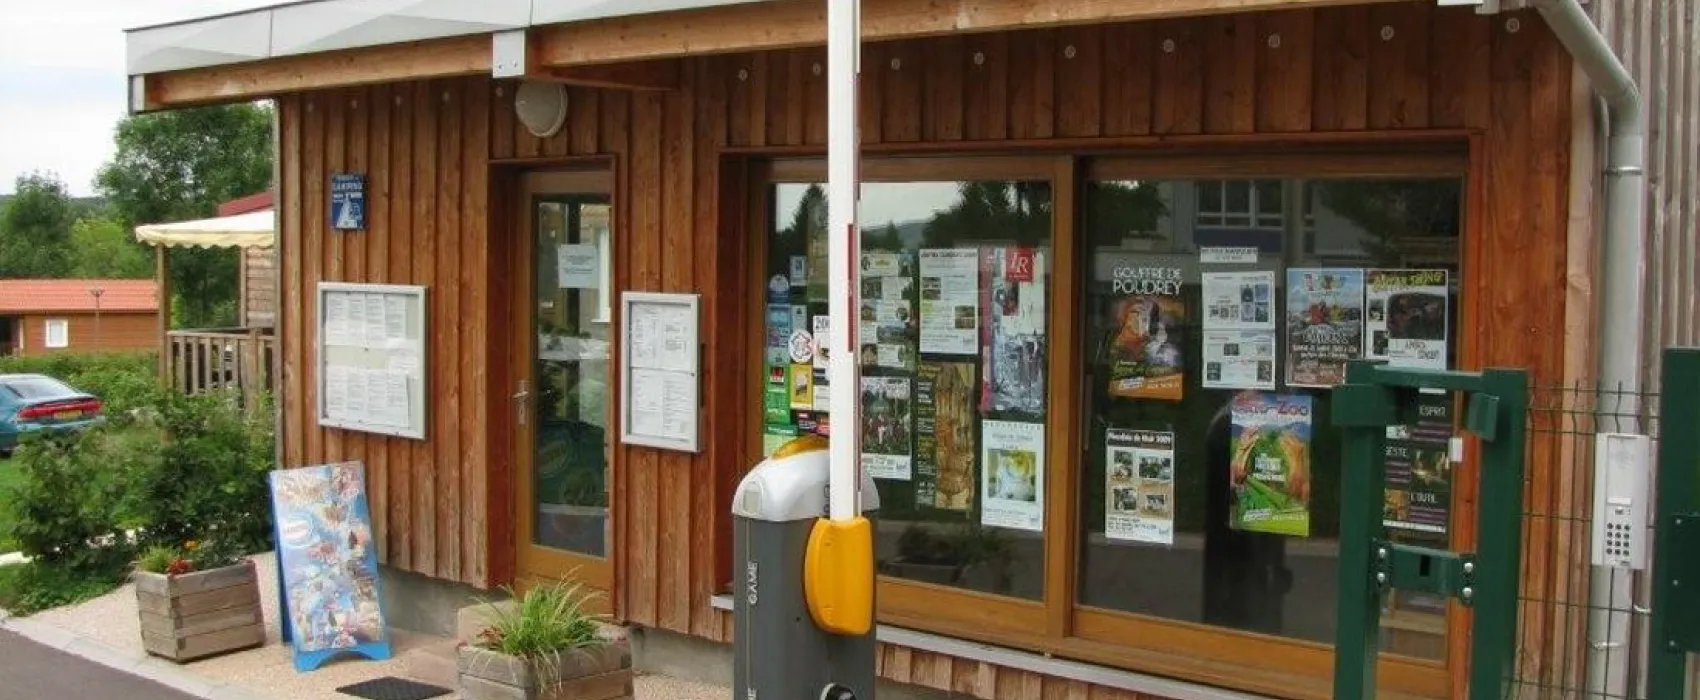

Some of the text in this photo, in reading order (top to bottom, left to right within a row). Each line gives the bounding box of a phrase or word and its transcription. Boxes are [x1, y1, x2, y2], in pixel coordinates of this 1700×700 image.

[1113, 267, 1182, 278] GOUFFRE DE
[1112, 279, 1183, 296] POUDREY
